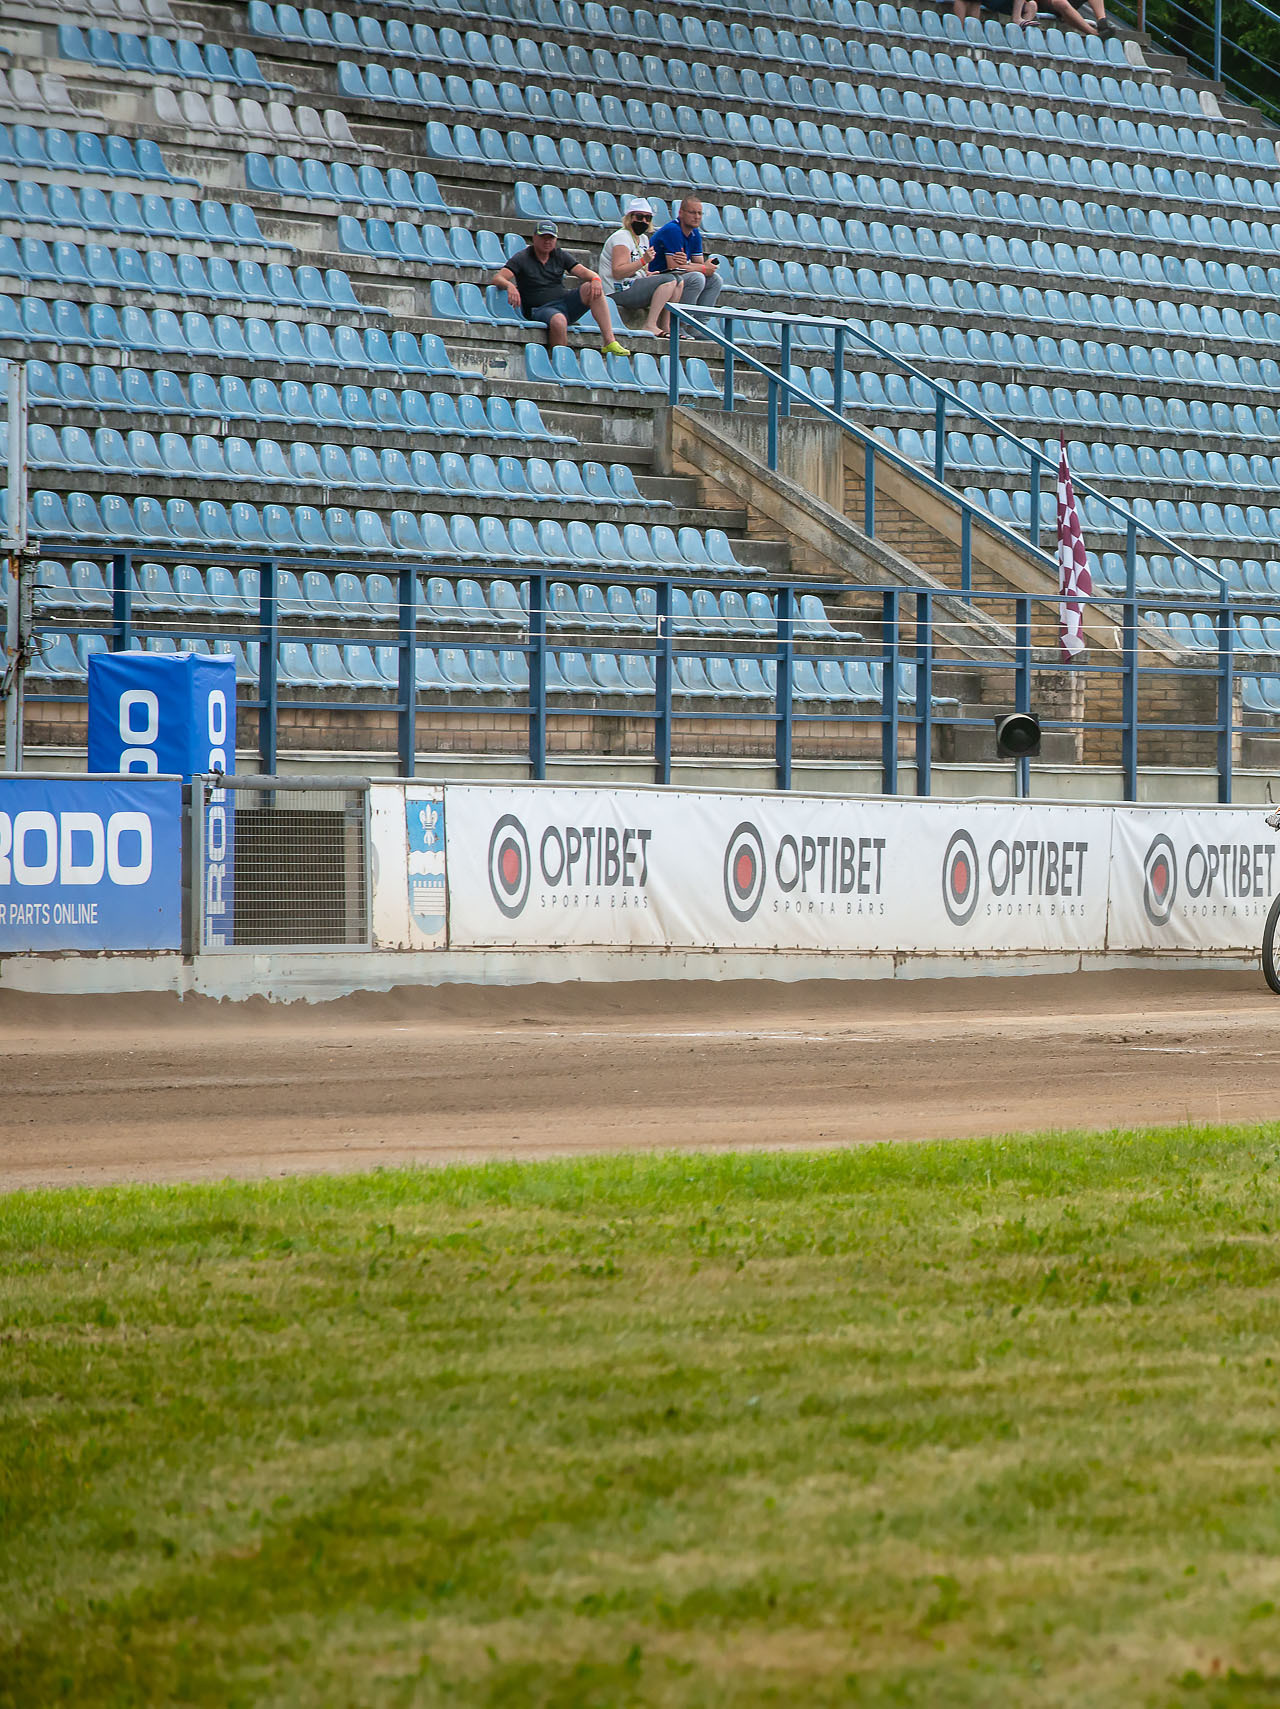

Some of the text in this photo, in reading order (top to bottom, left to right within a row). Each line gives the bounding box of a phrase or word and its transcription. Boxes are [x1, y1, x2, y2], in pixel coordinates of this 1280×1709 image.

[43, 495, 53, 507] 23
[77, 496, 87, 507] 24
[110, 499, 120, 510] 25
[175, 502, 185, 513] 27
[303, 510, 312, 520] 31
[334, 512, 343, 523] 32
[81, 567, 90, 578] 21
[279, 574, 289, 585] 27
[585, 589, 594, 599] 37
[0, 811, 153, 886] ODO
[540, 825, 652, 887] OPTIBET
[775, 834, 886, 895] OPTIBET
[988, 839, 1088, 897] OPTIBET
[1185, 843, 1276, 898] OPTIBET
[541, 892, 648, 908] SPORTA BĀRS
[773, 899, 884, 915] SPORTA BĀRS
[9, 903, 50, 924] PARTS
[53, 903, 98, 924] ONLINE
[987, 901, 1085, 916] SPORTA BĀRS
[1183, 903, 1267, 917] SPORTA BĀR
